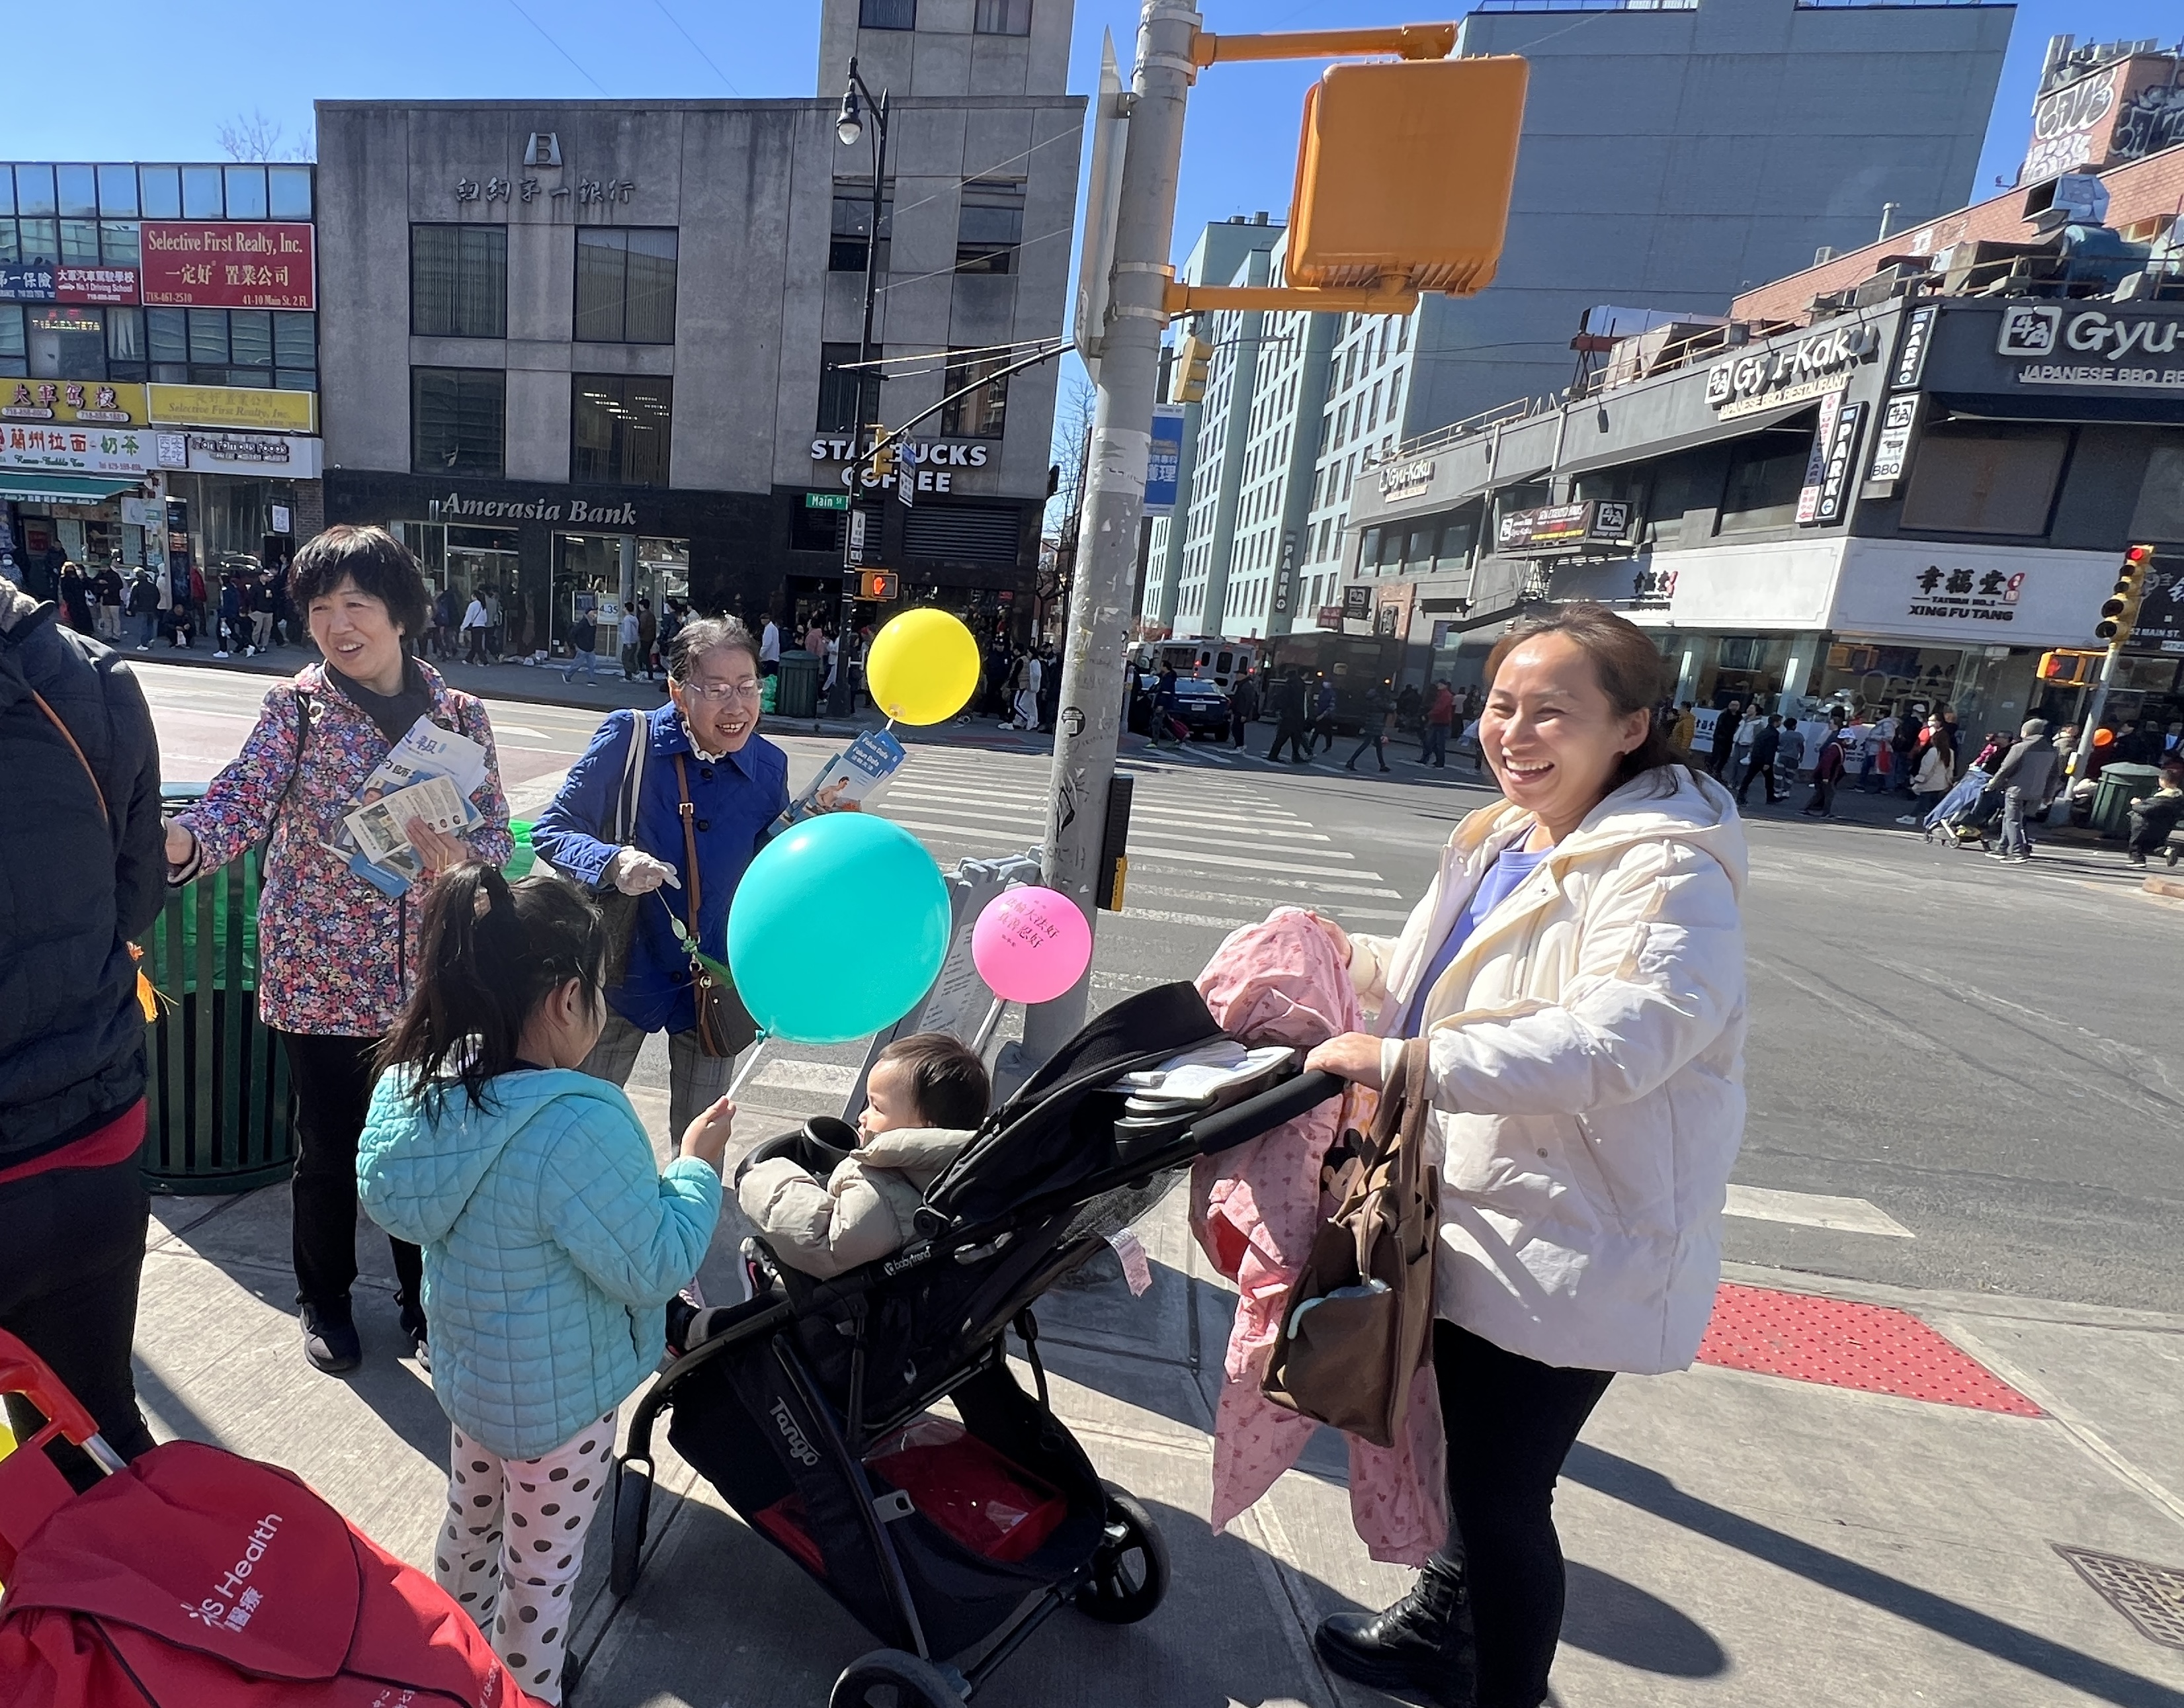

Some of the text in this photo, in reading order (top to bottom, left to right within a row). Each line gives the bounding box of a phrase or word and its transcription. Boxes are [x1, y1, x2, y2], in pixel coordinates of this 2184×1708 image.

[148, 230, 302, 256] Selective First Realty, Inc.
[165, 263, 289, 286] 一定好 置業公司
[90, 283, 111, 293] Driving
[242, 294, 263, 305] 41-10
[264, 294, 281, 306] Main
[292, 296, 298, 306] 2
[1900, 322, 1925, 371] PARK
[2021, 364, 2115, 382] JAPANESE
[2118, 368, 2158, 382] BBQ
[1720, 396, 1762, 415] JAPANESE
[101, 433, 139, 456] 奶茶
[1824, 423, 1852, 496] PARK
[1873, 464, 1900, 476] BBQ
[841, 466, 951, 493] COFEE
[442, 493, 637, 526] Amerasia Bank
[811, 495, 833, 507] Main
[1278, 544, 1293, 596] PARK
[1916, 566, 2006, 595] 幸福堂
[599, 605, 618, 614] 4.35
[1908, 605, 2013, 620] XING FU TANG
[853, 746, 868, 759] Falun
[862, 737, 877, 751] Falun
[894, 1246, 931, 1270] babytrend
[769, 1396, 820, 1467] Tango
[214, 1513, 283, 1599] Health
